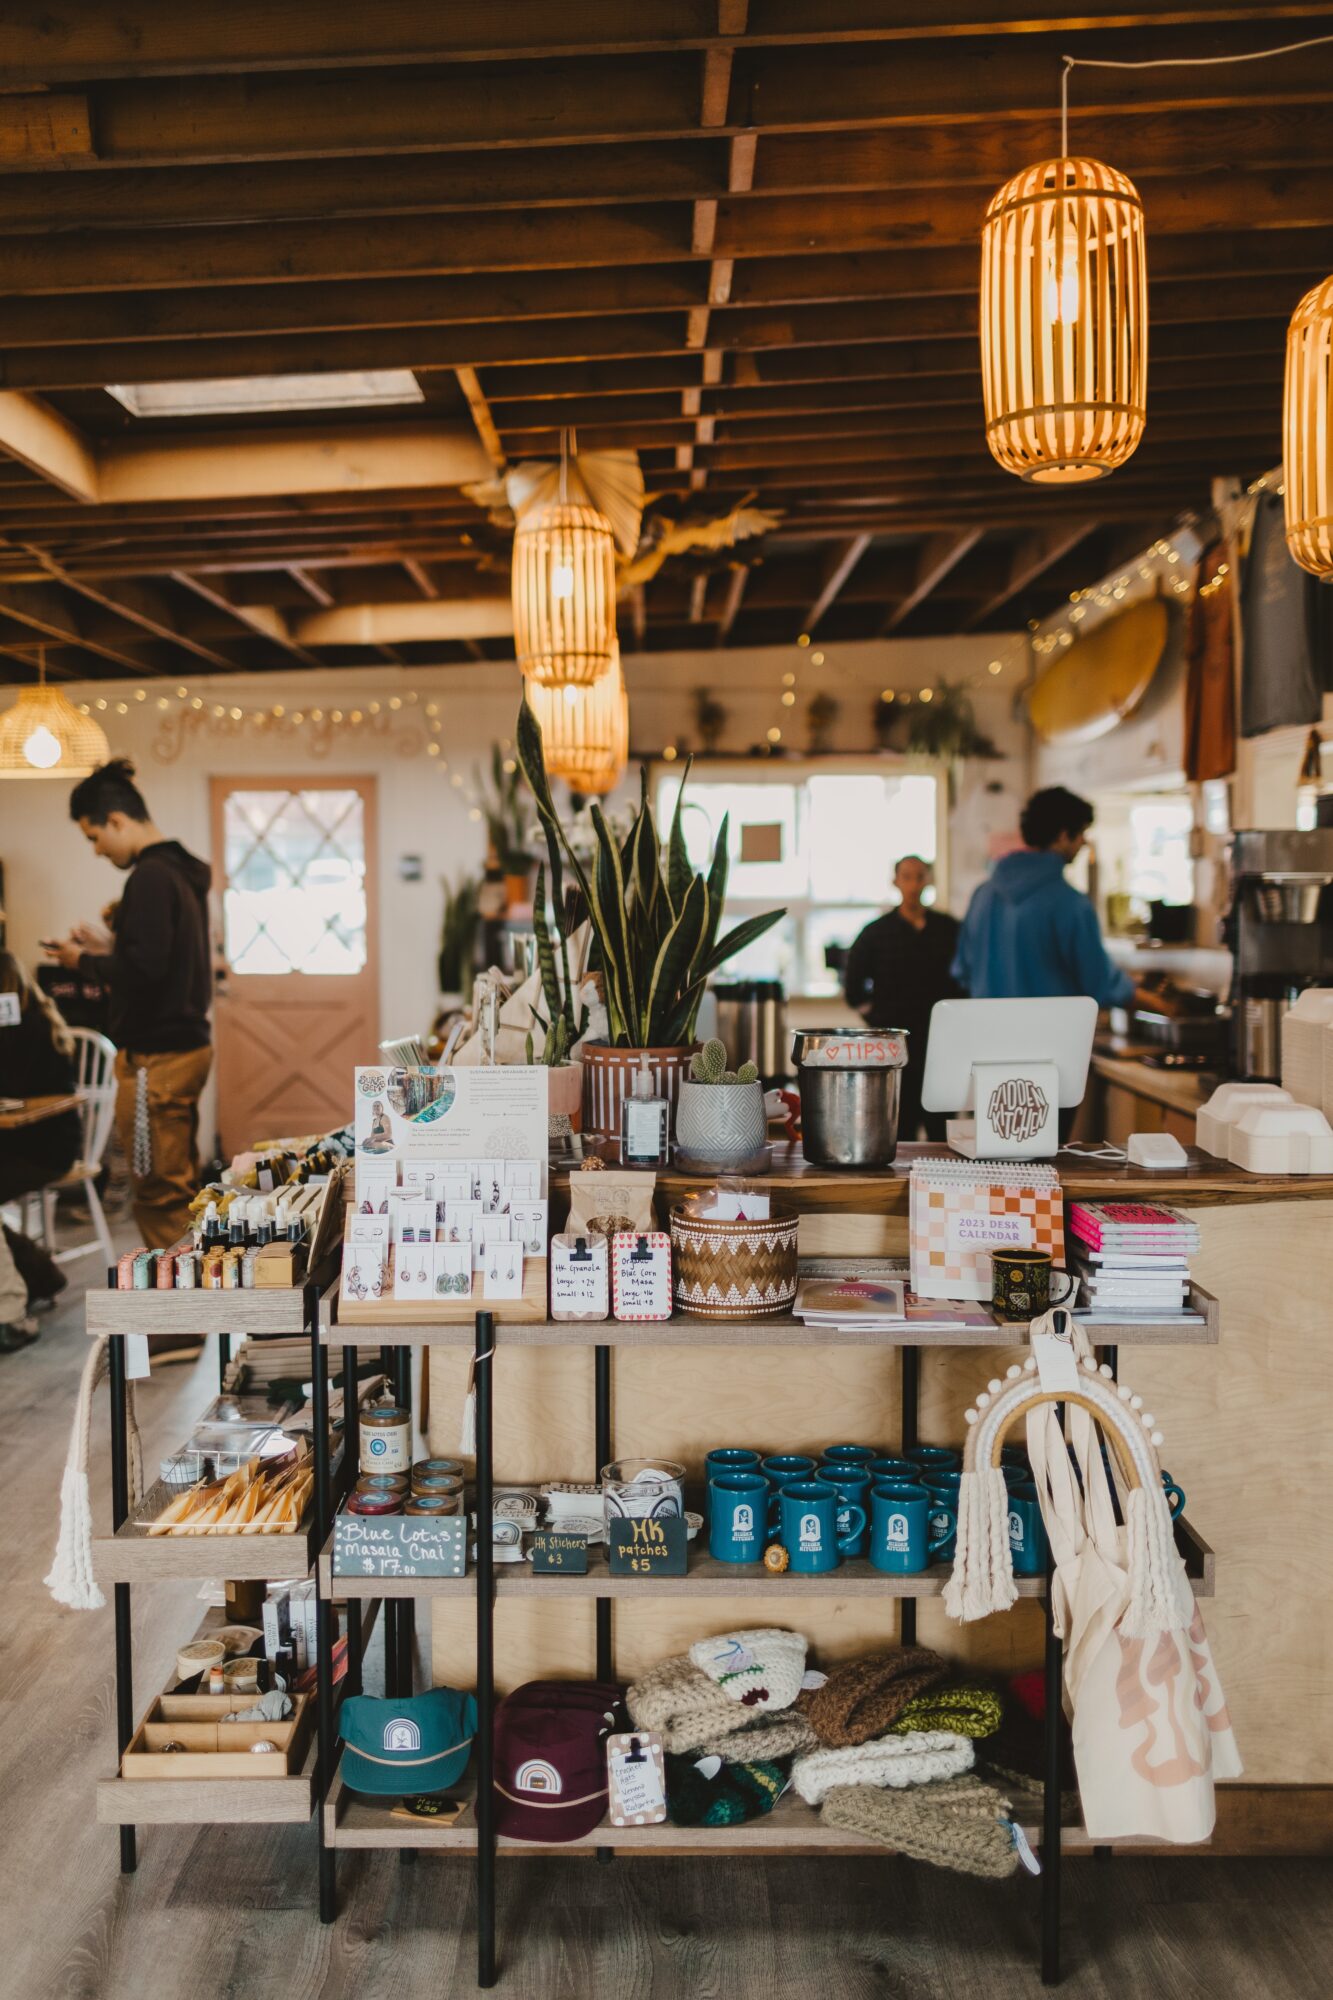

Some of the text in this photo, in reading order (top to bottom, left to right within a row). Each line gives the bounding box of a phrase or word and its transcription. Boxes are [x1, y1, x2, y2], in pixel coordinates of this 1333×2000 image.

[842, 1041, 886, 1061] TIPS
[359, 1075, 385, 1086] SURF
[987, 1078, 1048, 1119] HIDDEN
[992, 1102, 1050, 1143] KITCHEN
[959, 1218, 1020, 1230] 2023 DESK
[959, 1230, 1021, 1241] CALENDAR
[555, 1264, 602, 1275] HK Granola
[640, 1269, 658, 1277] Corn
[631, 1278, 655, 1286] Masa
[342, 1522, 451, 1543] Blue Lotus
[631, 1519, 665, 1544] HK
[345, 1542, 403, 1558] Masala
[533, 1536, 586, 1552] HK Stickers
[618, 1543, 669, 1558] patches
[548, 1553, 563, 1565] $3
[631, 1558, 651, 1572] $5
